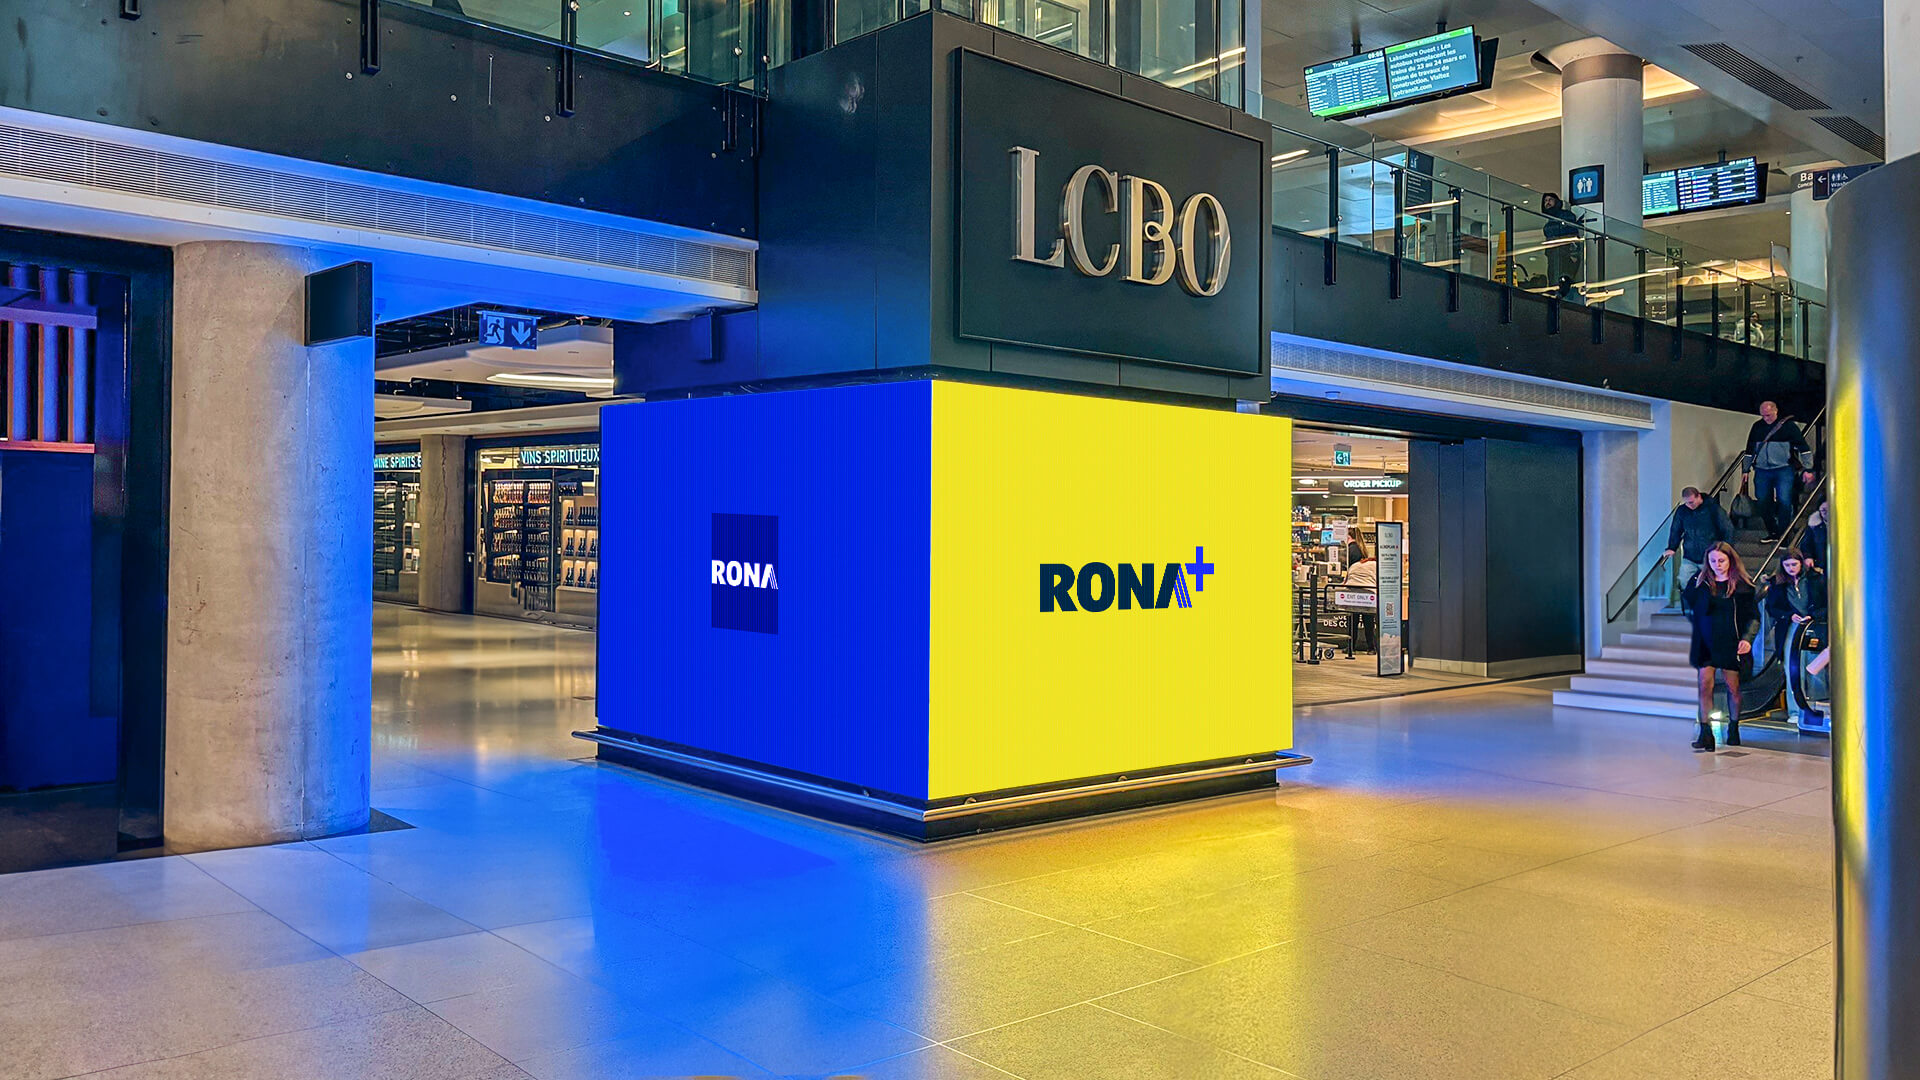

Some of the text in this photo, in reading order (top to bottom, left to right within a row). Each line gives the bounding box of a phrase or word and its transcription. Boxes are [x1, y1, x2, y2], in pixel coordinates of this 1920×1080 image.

[1389, 51, 1418, 62] Lakeshore
[1419, 46, 1436, 55] Ouest
[1390, 60, 1413, 69] autobus
[1414, 53, 1447, 65] remplacent
[1332, 60, 1349, 68] Trains
[1391, 67, 1407, 76] trains
[1434, 59, 1442, 67] 24
[1443, 56, 1458, 64] mars
[1392, 73, 1409, 83] raison
[1418, 67, 1441, 77] travaux
[1392, 72, 1450, 89] construction. Visitez
[1393, 84, 1433, 98] gotransit.com
[1800, 172, 1813, 181] Ba
[1008, 146, 1231, 297] LCBO
[391, 456, 416, 468] SPIRITS
[521, 448, 600, 464] VINS SPIRITUEUX
[1344, 480, 1402, 488] ORDER PICKUP
[711, 560, 778, 590] RONA
[1323, 619, 1338, 627] DES
